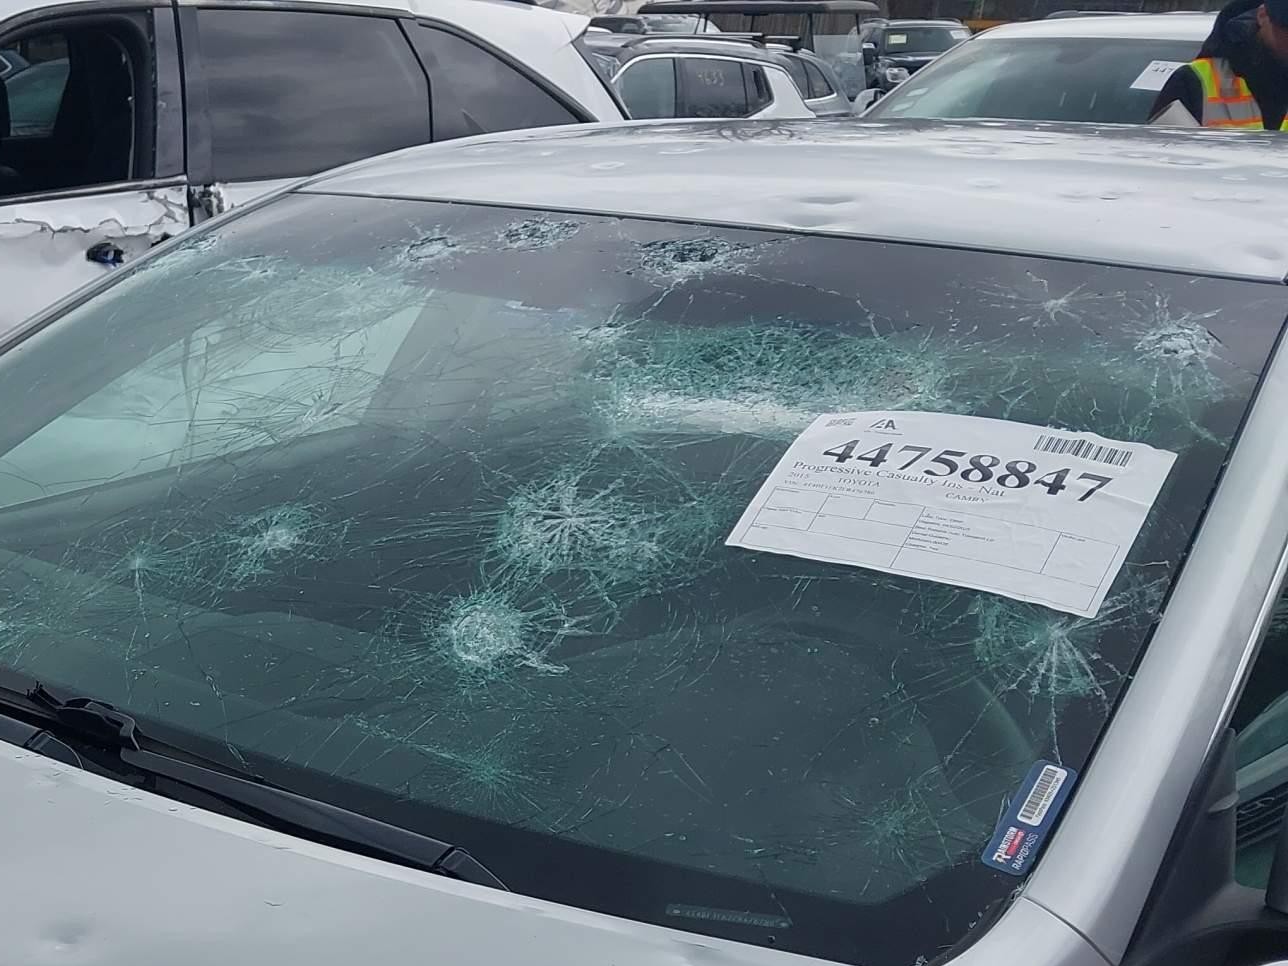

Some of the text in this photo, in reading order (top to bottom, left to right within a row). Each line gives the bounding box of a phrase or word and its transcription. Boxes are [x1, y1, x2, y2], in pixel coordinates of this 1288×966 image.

[793, 461, 873, 478] Progressive
[876, 469, 938, 486] Casualty
[941, 478, 964, 490] Ins
[978, 485, 1005, 497] Nat
[823, 439, 1113, 502] 44758847
[838, 477, 881, 488] TOYOTA
